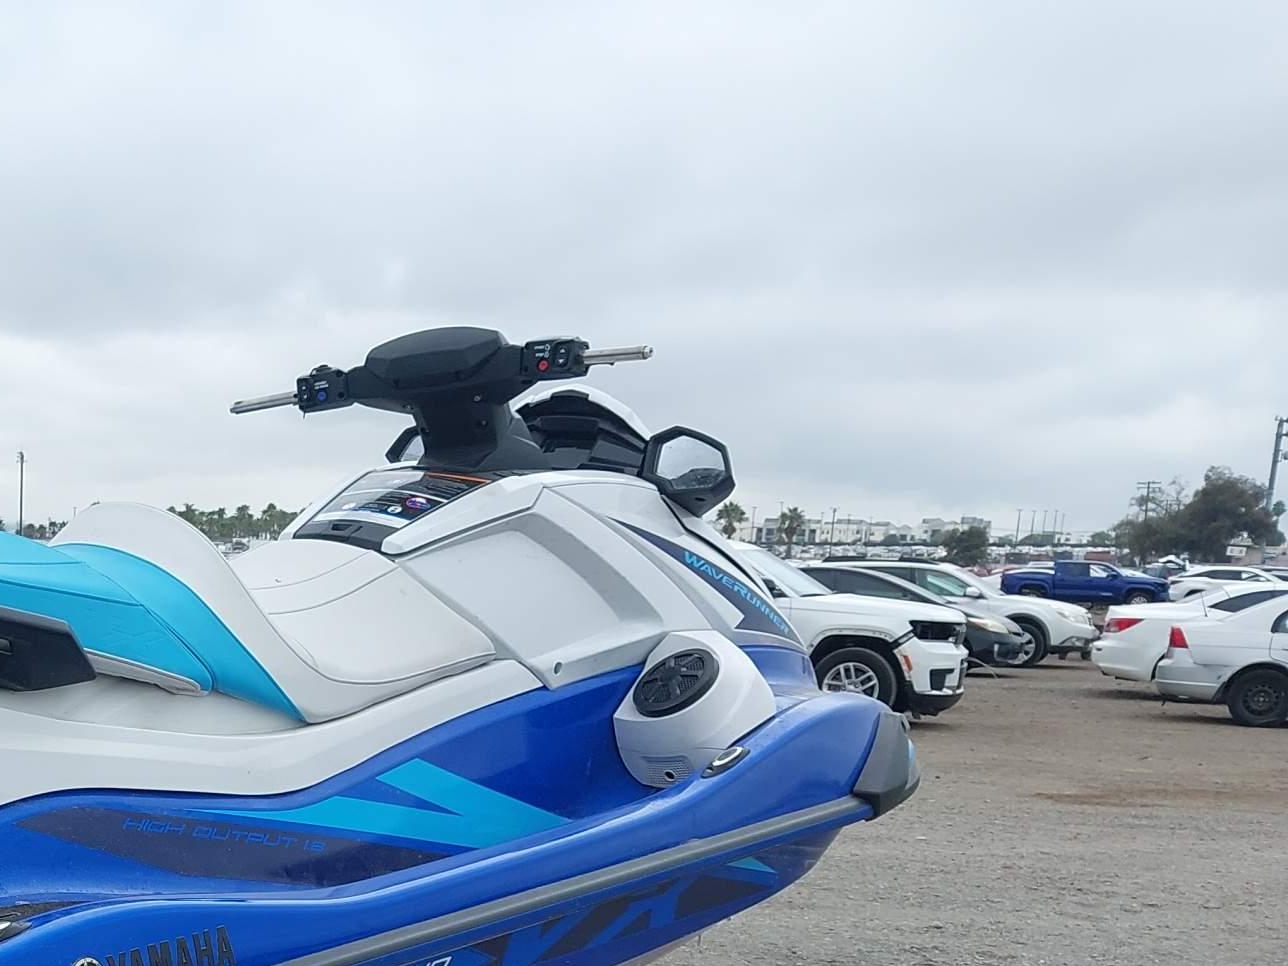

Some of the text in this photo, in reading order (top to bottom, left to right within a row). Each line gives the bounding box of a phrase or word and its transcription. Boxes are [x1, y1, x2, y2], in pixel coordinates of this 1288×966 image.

[684, 552, 789, 633] WAVERUNNER
[123, 817, 326, 852] HIGH OUTPUT 1.8
